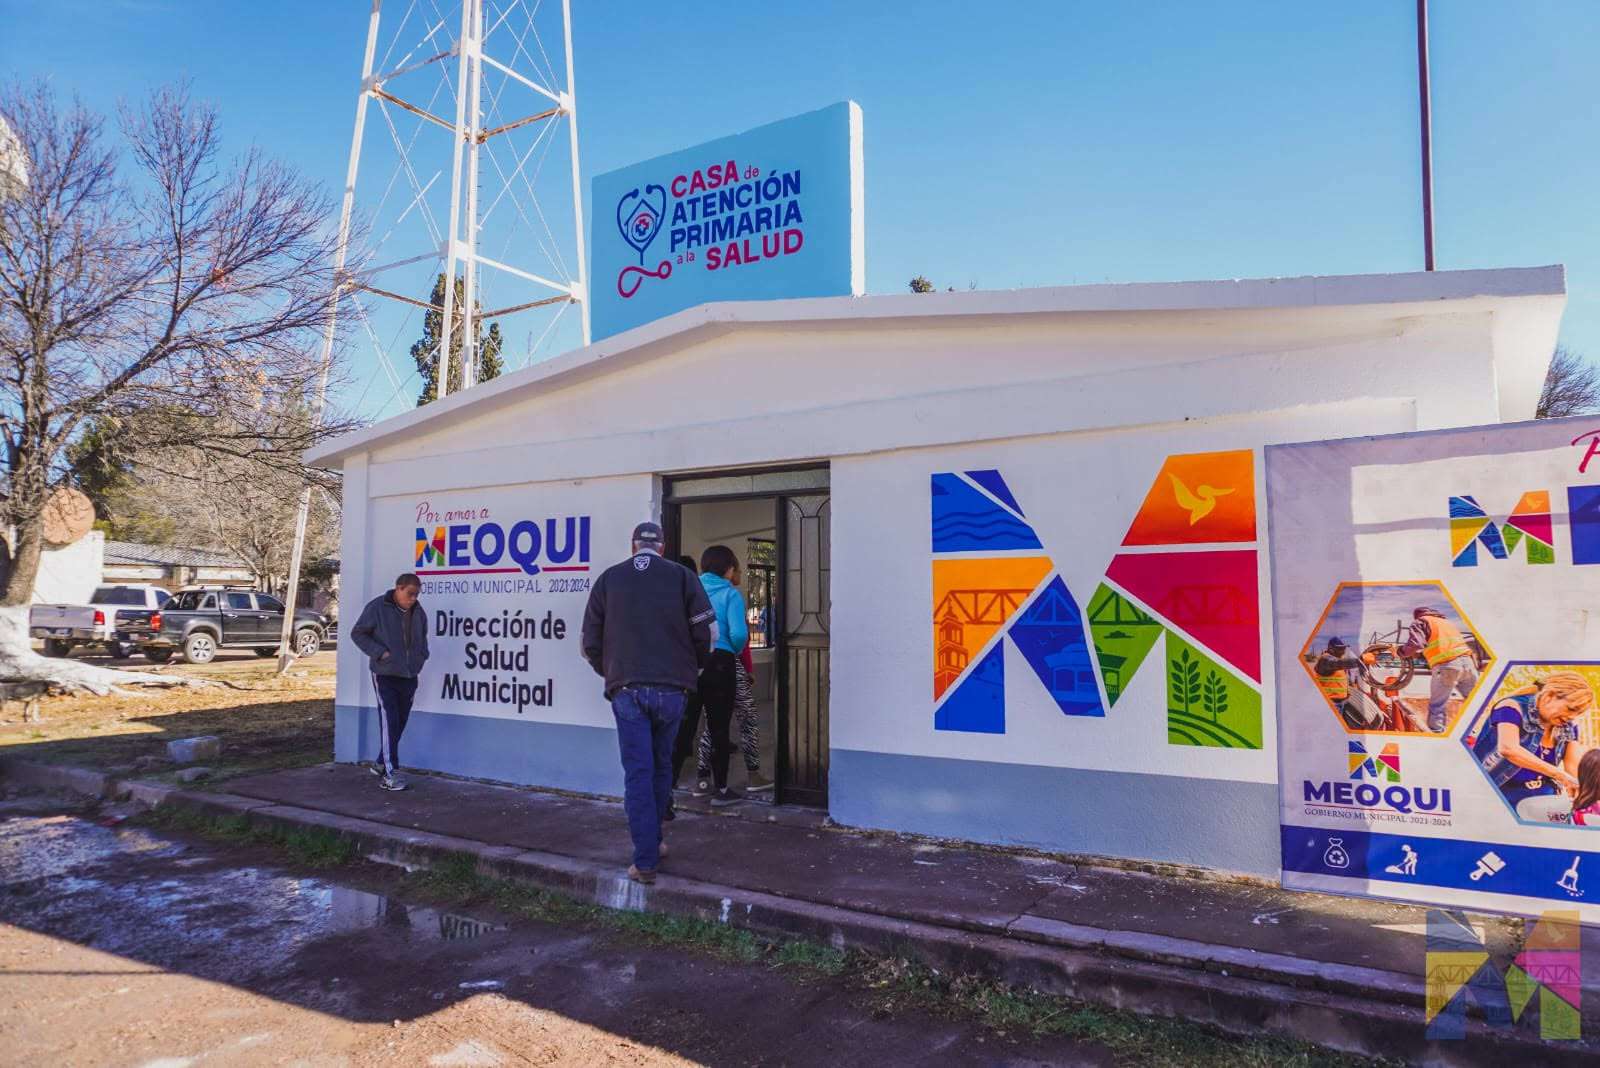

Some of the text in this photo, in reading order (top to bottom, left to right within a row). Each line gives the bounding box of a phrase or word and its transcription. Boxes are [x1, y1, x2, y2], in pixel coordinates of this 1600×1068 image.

[671, 160, 760, 198] CASA de
[671, 170, 801, 226] ATENCIÓN
[670, 200, 803, 253] PRIMARIA
[677, 229, 804, 271] a la SALUD
[416, 502, 489, 523] Por amor a
[415, 516, 591, 575] MEOQUI
[421, 581, 469, 595] OBIERNO
[473, 579, 542, 594] MUNICIPAL
[436, 610, 567, 640] Dirección de
[464, 642, 529, 672] Salud
[441, 674, 553, 713] Municipal
[1303, 780, 1452, 814] MEOQUI
[1304, 807, 1352, 819] GOBIERNO
[1353, 812, 1407, 823] MUNICIPAL
